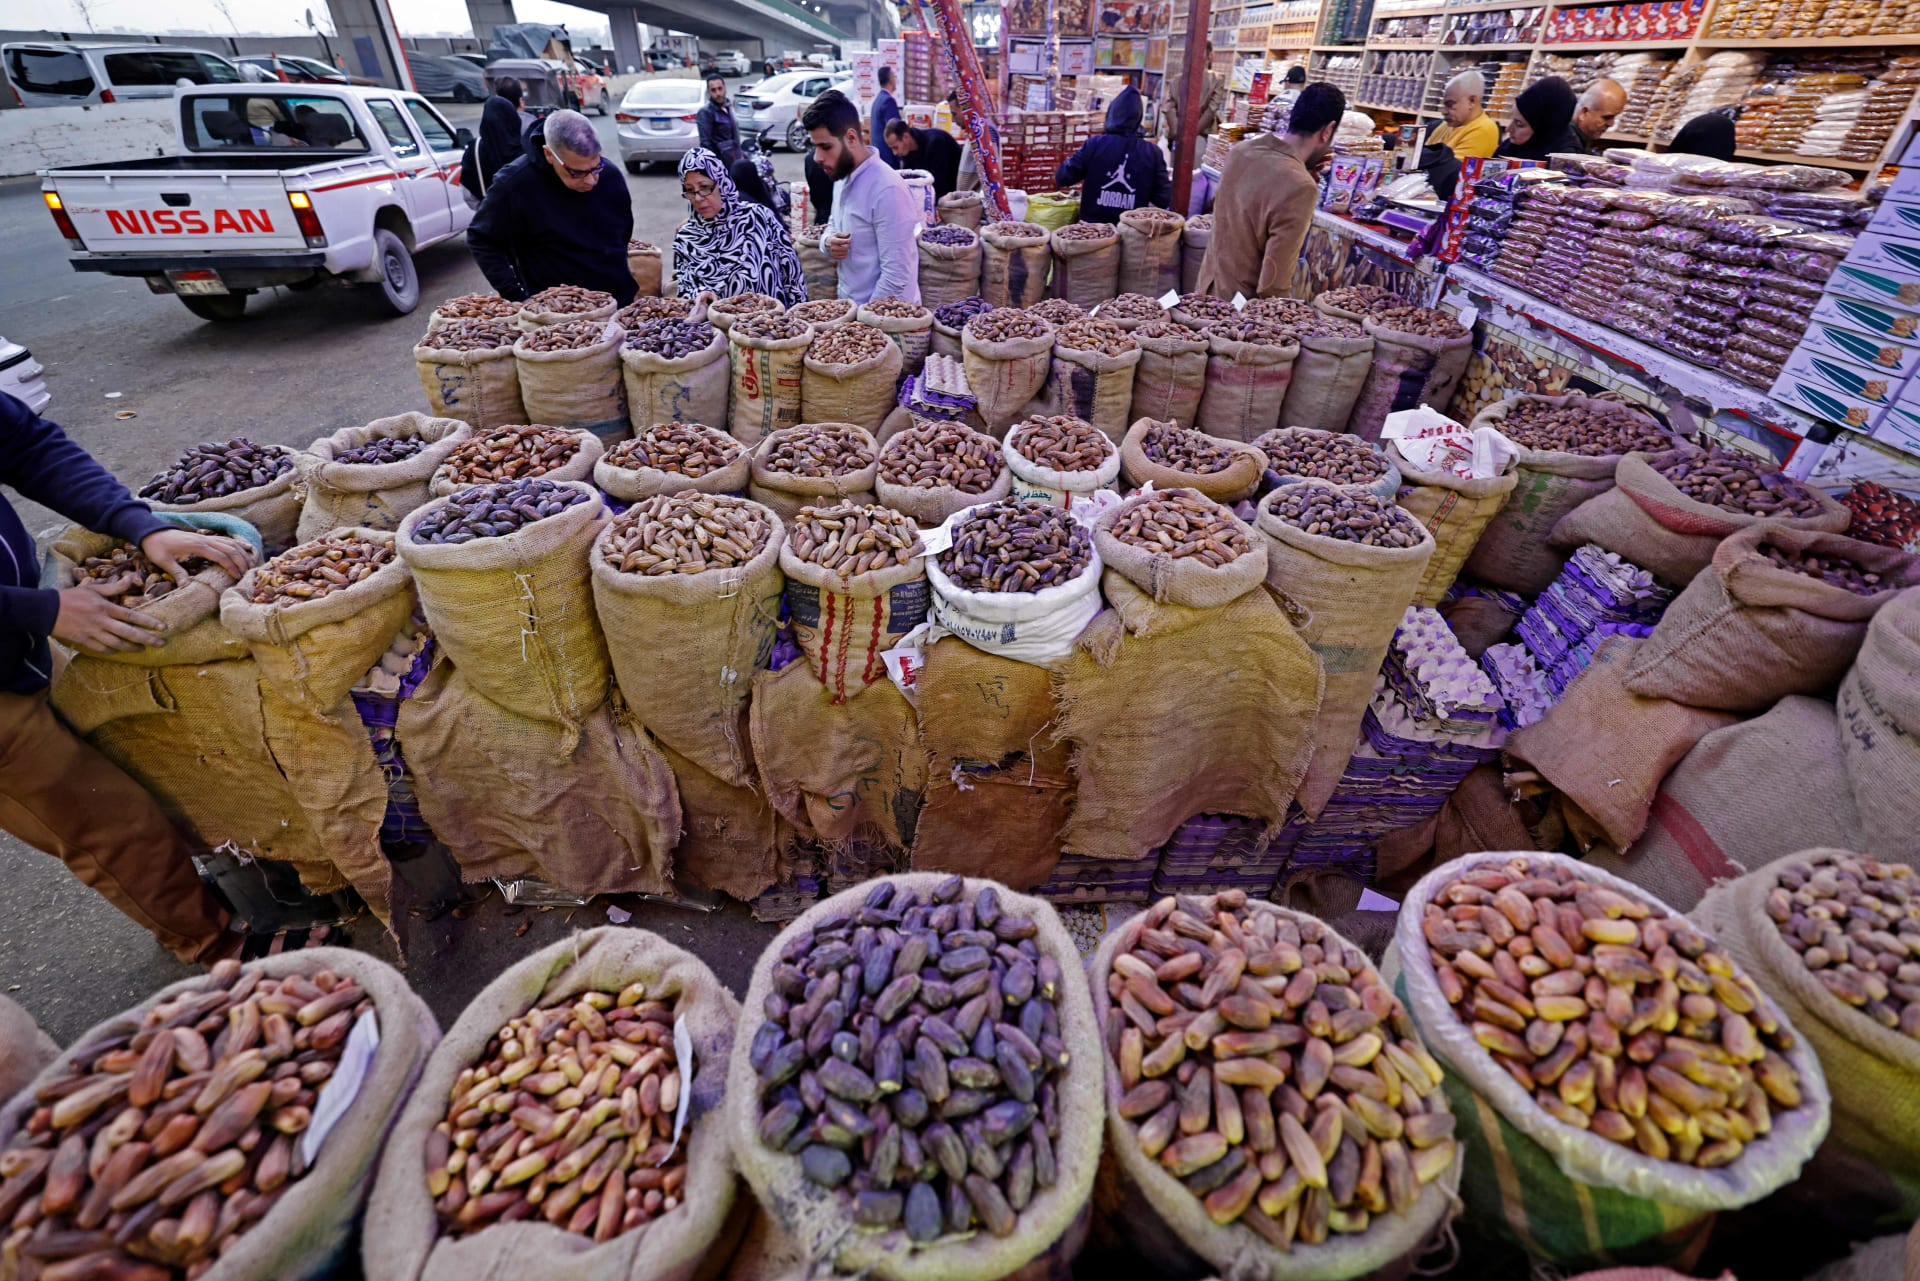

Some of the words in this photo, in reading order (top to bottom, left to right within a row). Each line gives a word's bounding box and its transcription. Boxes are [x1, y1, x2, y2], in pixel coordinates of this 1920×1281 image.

[1096, 190, 1136, 209] JORDAN
[105, 208, 275, 235] NISSAN
[1030, 488, 1053, 502] يحفظ
